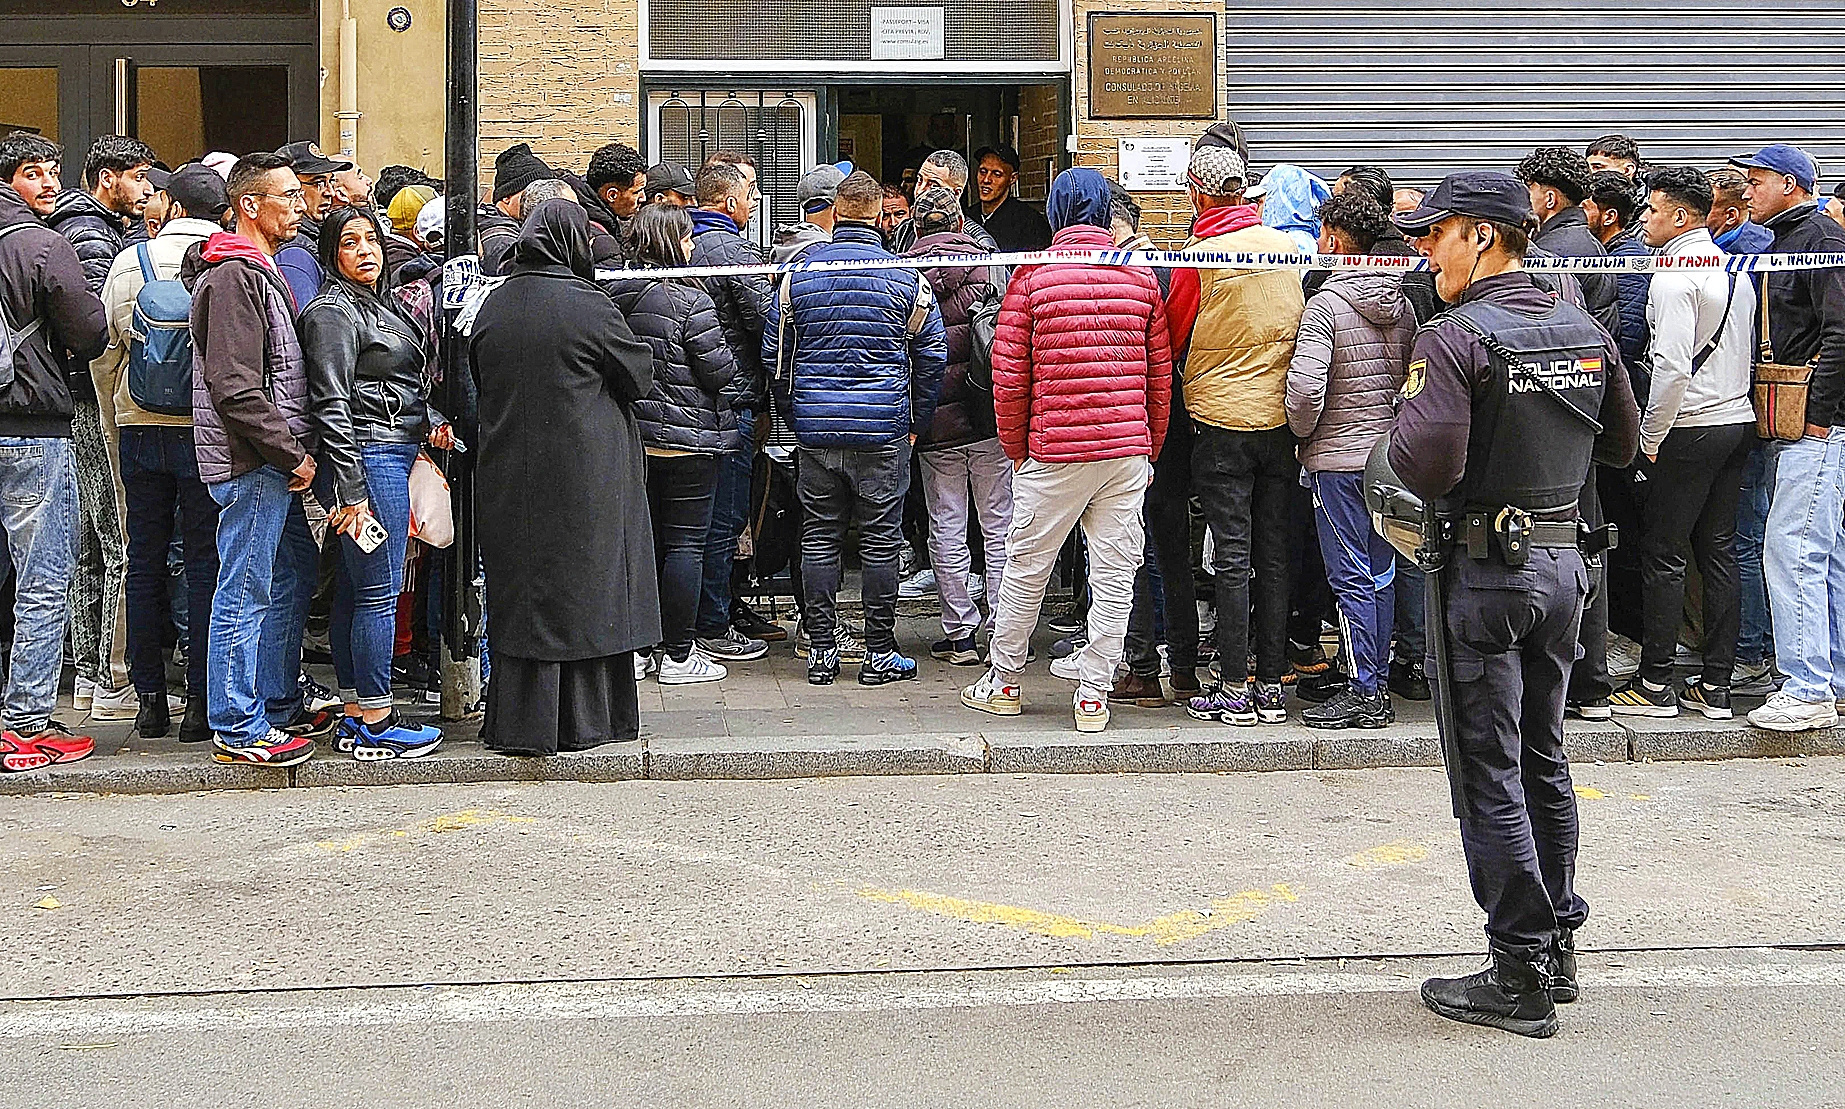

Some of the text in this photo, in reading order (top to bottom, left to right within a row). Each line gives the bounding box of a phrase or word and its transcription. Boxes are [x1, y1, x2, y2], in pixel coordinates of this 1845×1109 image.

[1105, 82, 1153, 92] CONSULADO
[1127, 95, 1139, 104] EN
[1164, 251, 1232, 263] NACIONAL
[1236, 252, 1254, 263] DE
[1258, 253, 1313, 265] POLICIA
[1547, 258, 1569, 268] DE
[1573, 257, 1626, 268] POLICIA
[1656, 256, 1674, 267] NO
[1788, 253, 1845, 266] NACIONA
